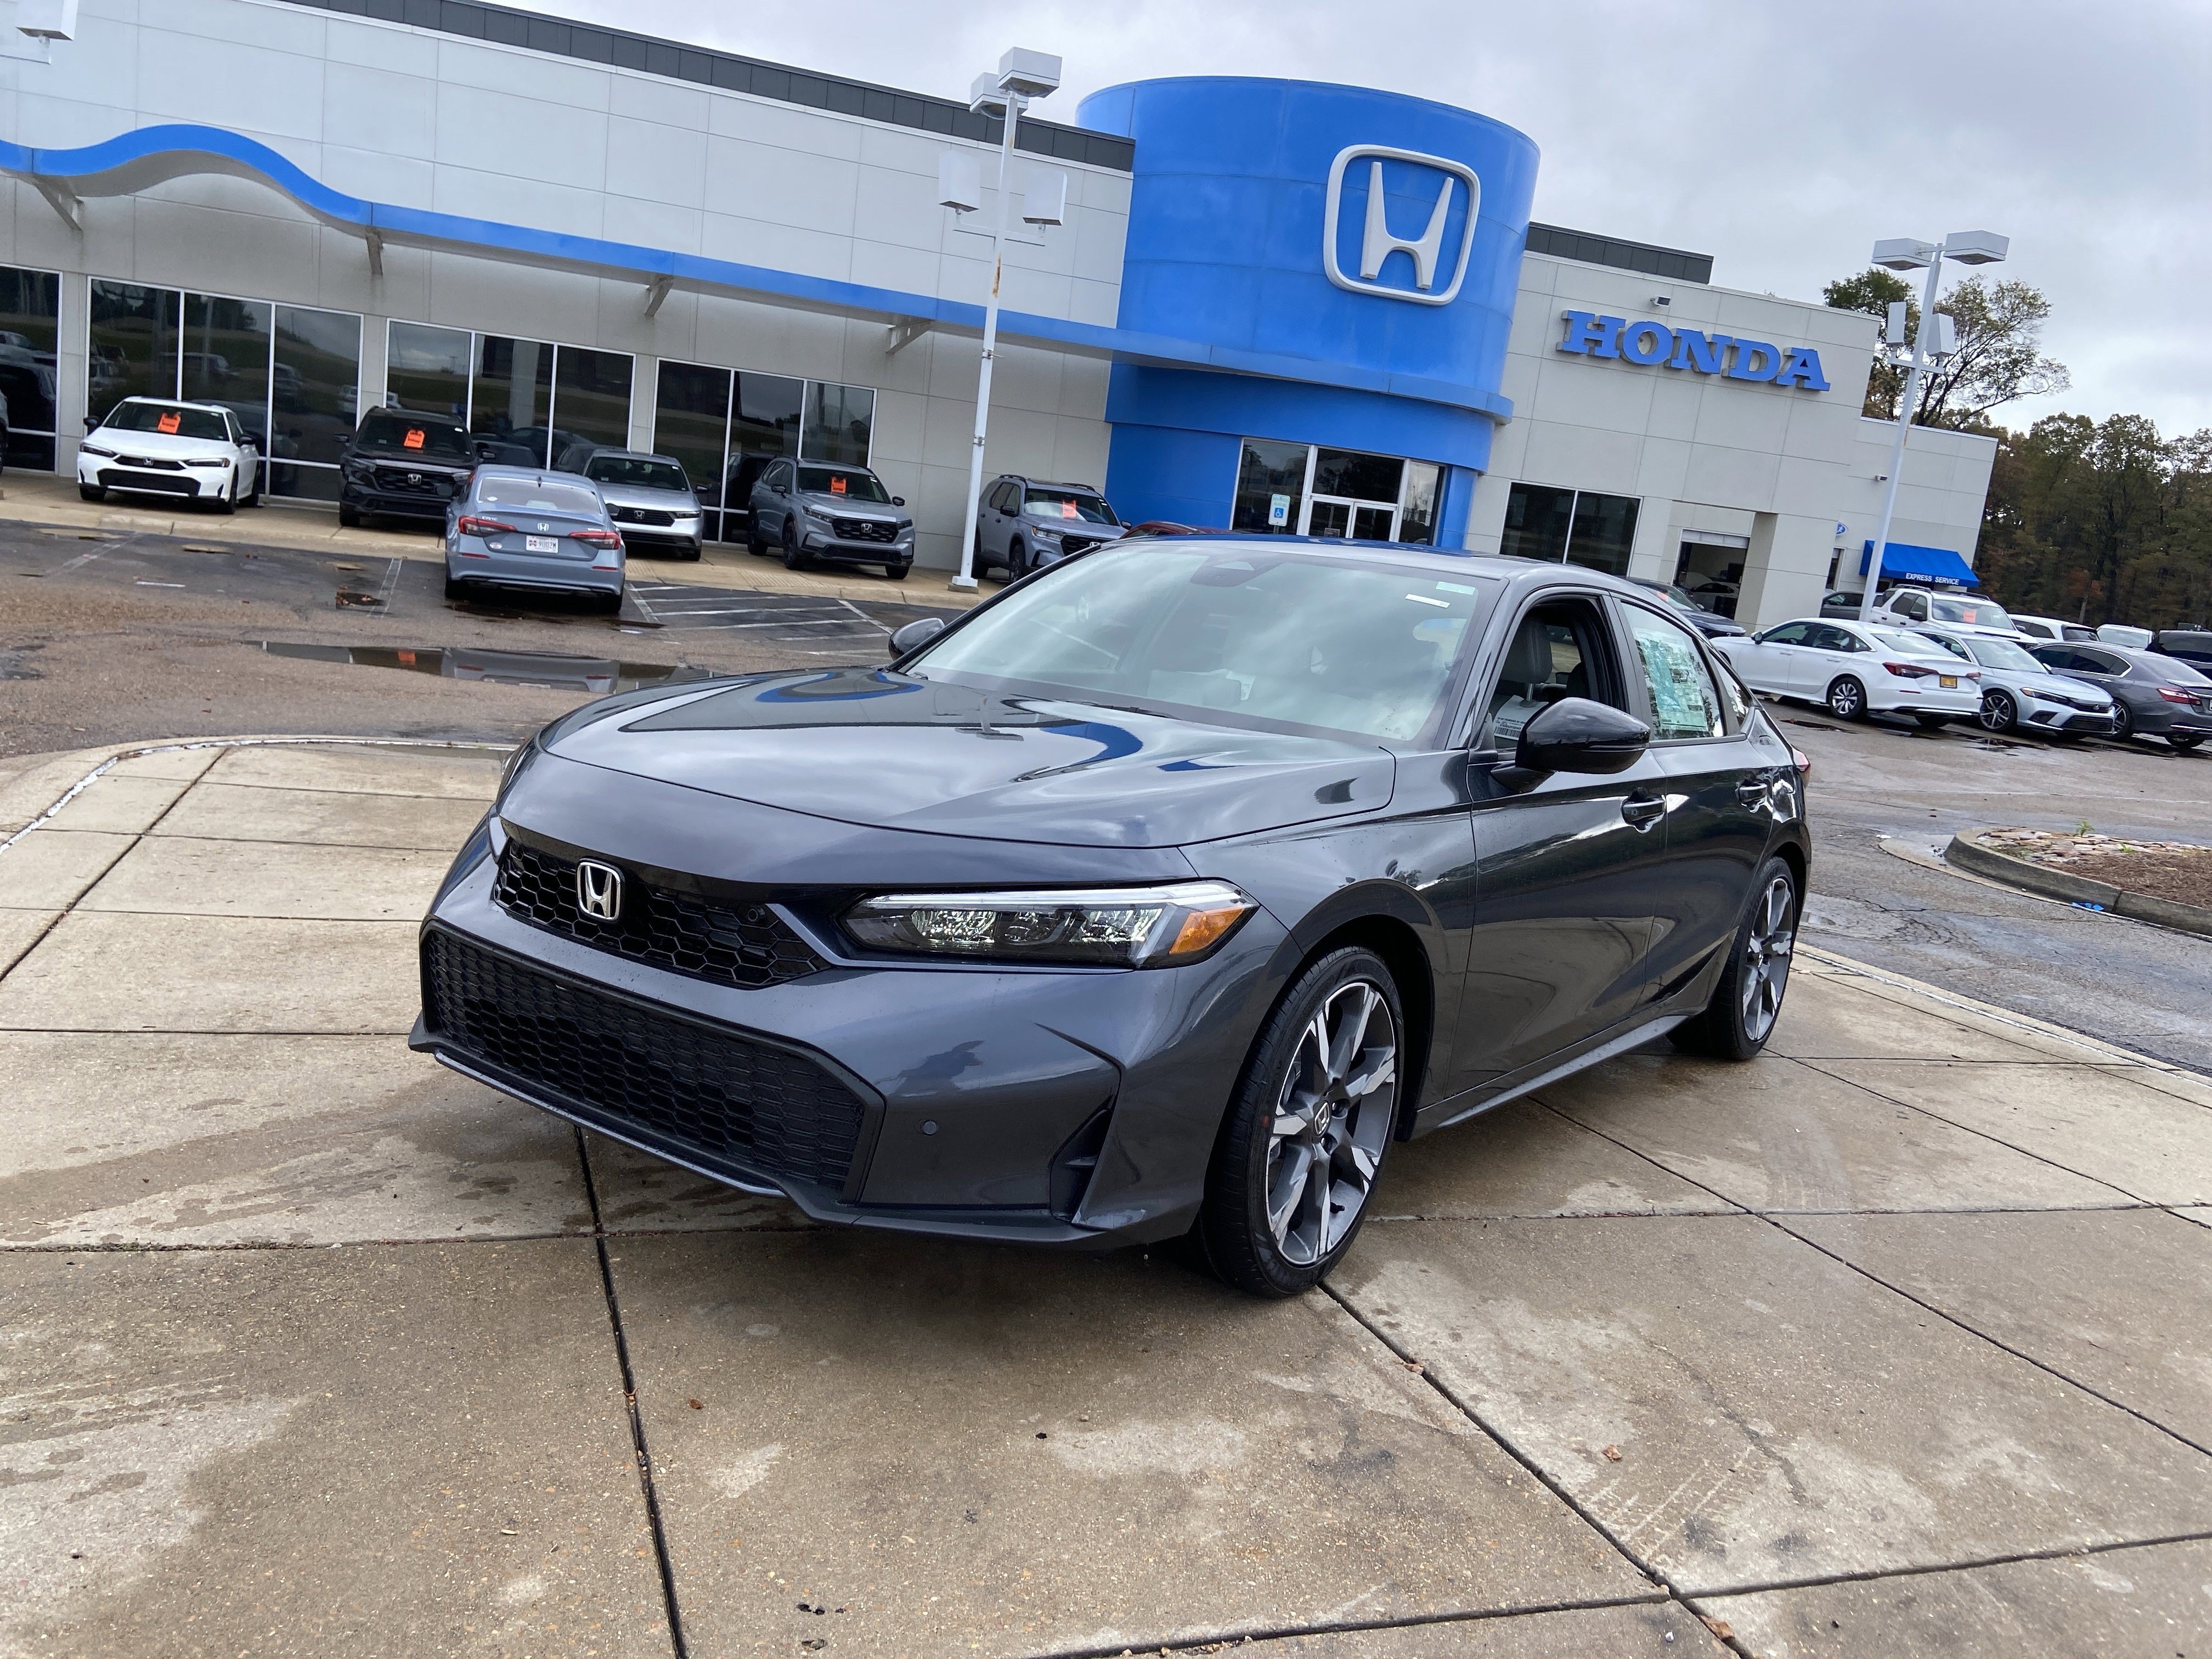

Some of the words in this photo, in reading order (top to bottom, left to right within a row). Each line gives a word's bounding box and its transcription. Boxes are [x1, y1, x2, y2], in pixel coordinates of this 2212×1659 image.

[1556, 309, 1831, 391] HONDA
[1905, 572, 1932, 582] EXPRESS
[1934, 576, 1960, 585] SERVICE
